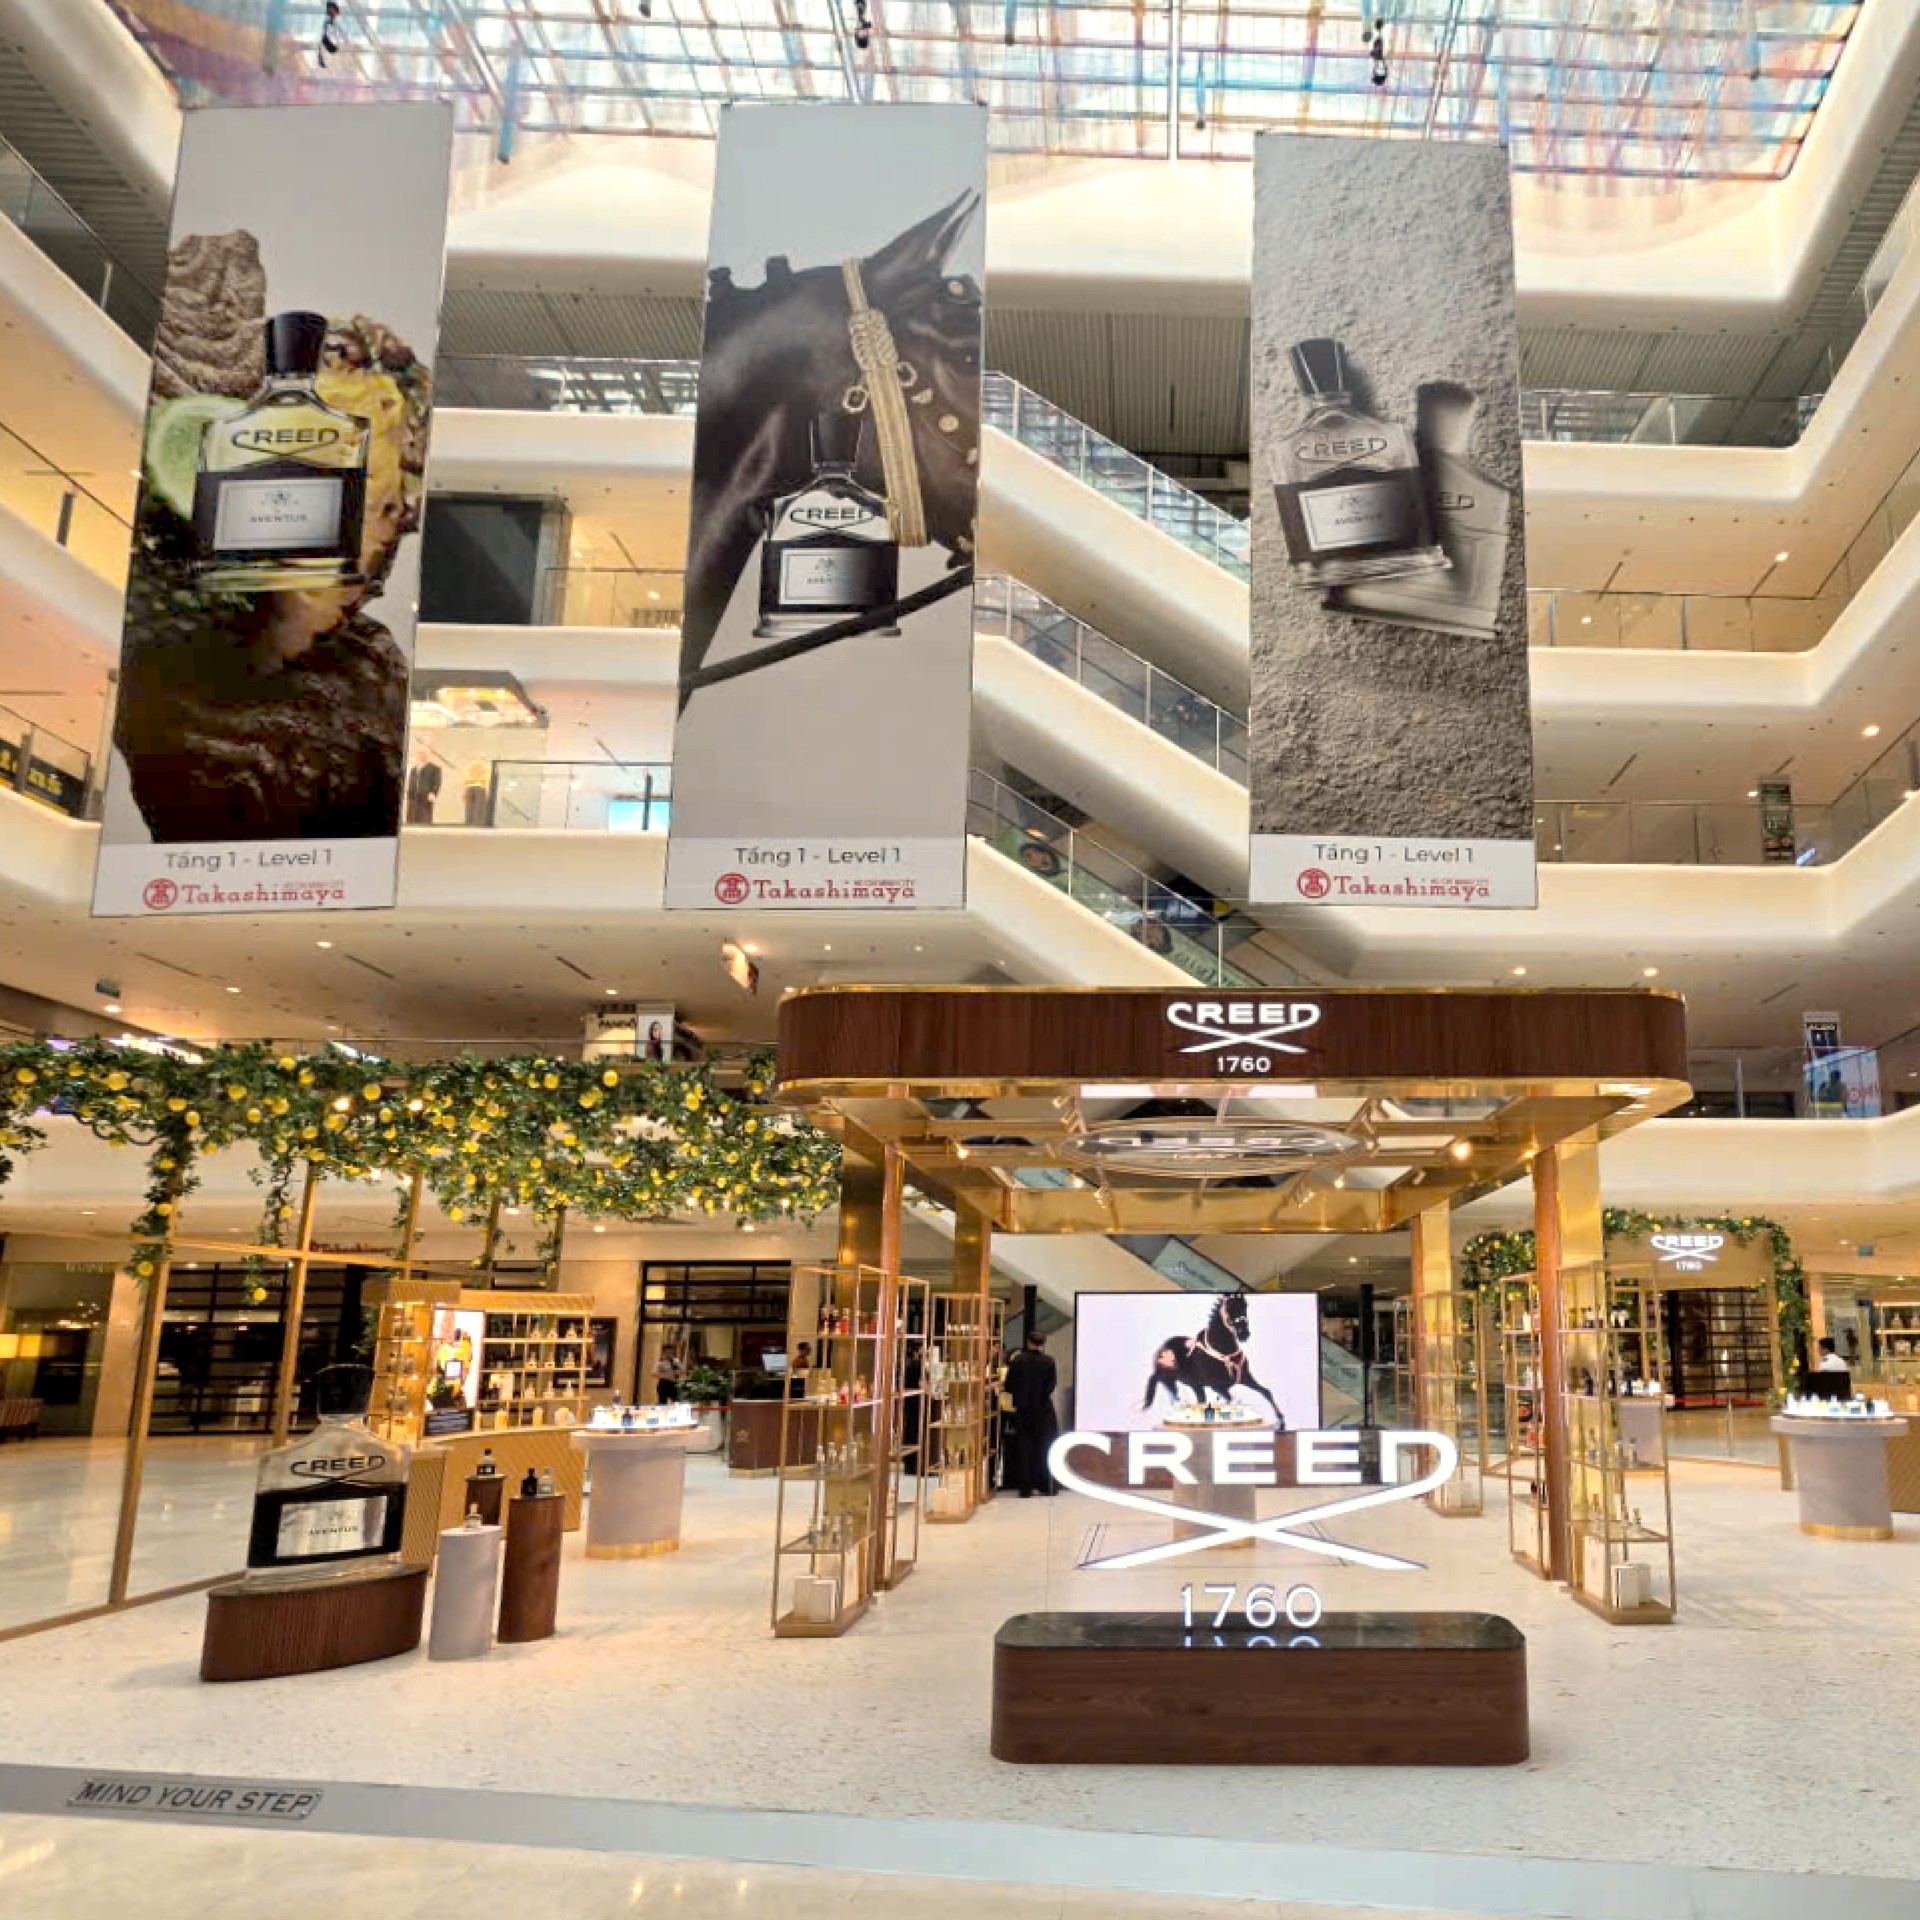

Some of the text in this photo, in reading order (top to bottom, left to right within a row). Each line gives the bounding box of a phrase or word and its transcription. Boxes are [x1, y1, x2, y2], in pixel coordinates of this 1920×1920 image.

[231, 427, 340, 456] CREED
[1295, 436, 1388, 466] CREED
[228, 851, 236, 867] 1
[259, 848, 317, 867] Level
[324, 848, 332, 865] 1
[797, 847, 805, 864] 1
[828, 847, 886, 864] Level
[893, 847, 901, 863] 1
[1375, 845, 1382, 861] 1
[1404, 846, 1459, 863] Level
[1465, 847, 1474, 863] 1
[181, 882, 345, 906] Takashimaya
[753, 879, 915, 903] Takashimaya
[1334, 875, 1490, 902] Takashimaya
[1217, 1055, 1271, 1073] 1760
[290, 1454, 386, 1481] CREED
[1180, 1581, 1323, 1629] 1760
[75, 1781, 314, 1813] MIND YOUR STEP
